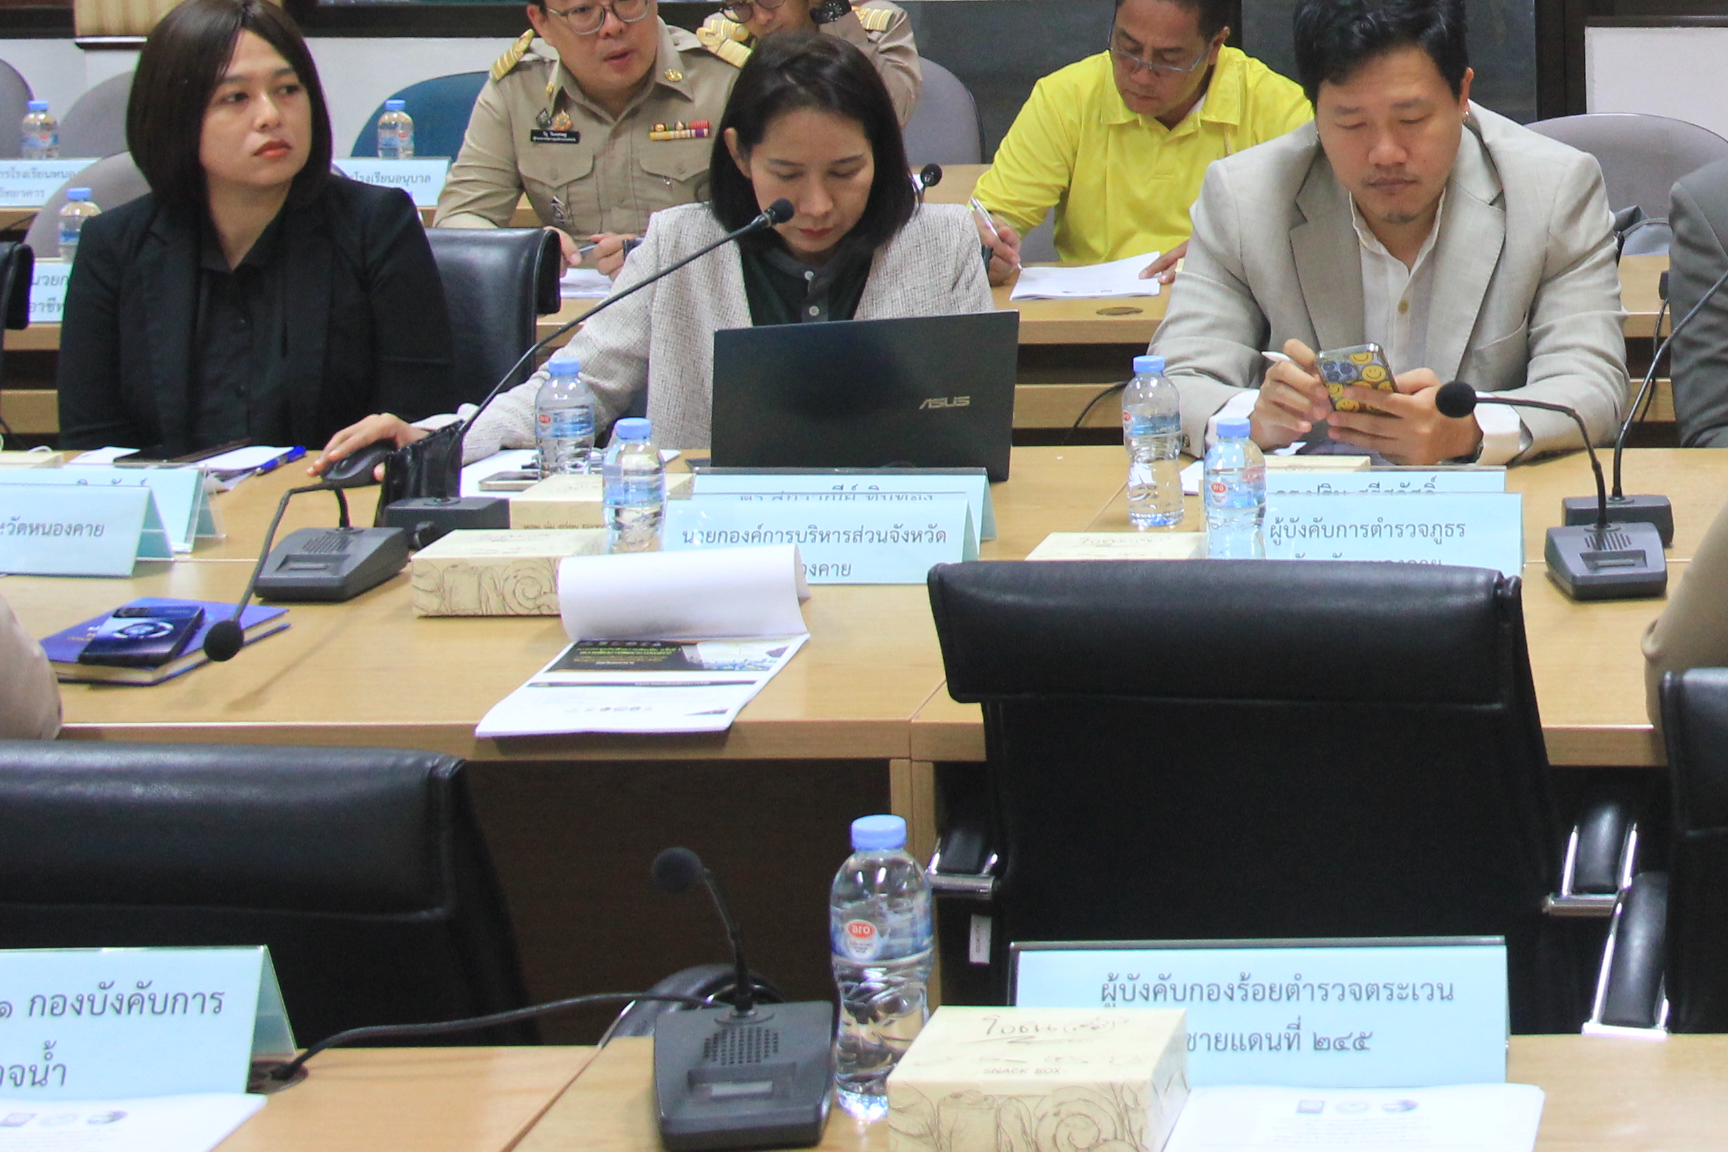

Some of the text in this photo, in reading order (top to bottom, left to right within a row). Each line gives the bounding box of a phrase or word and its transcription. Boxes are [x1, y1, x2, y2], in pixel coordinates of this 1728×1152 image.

[919, 395, 971, 409] ASUS
[1269, 517, 1467, 546] ผู้บังคับการตำรวจภูธร
[28, 980, 226, 1017] กองบังคับการ
[1100, 972, 1455, 1008] ผู้บังคับกองร้อยตำรวจตระเวน
[1312, 1031, 1374, 1052] ๒๔๕
[0, 1039, 67, 1087] จน้ำ
